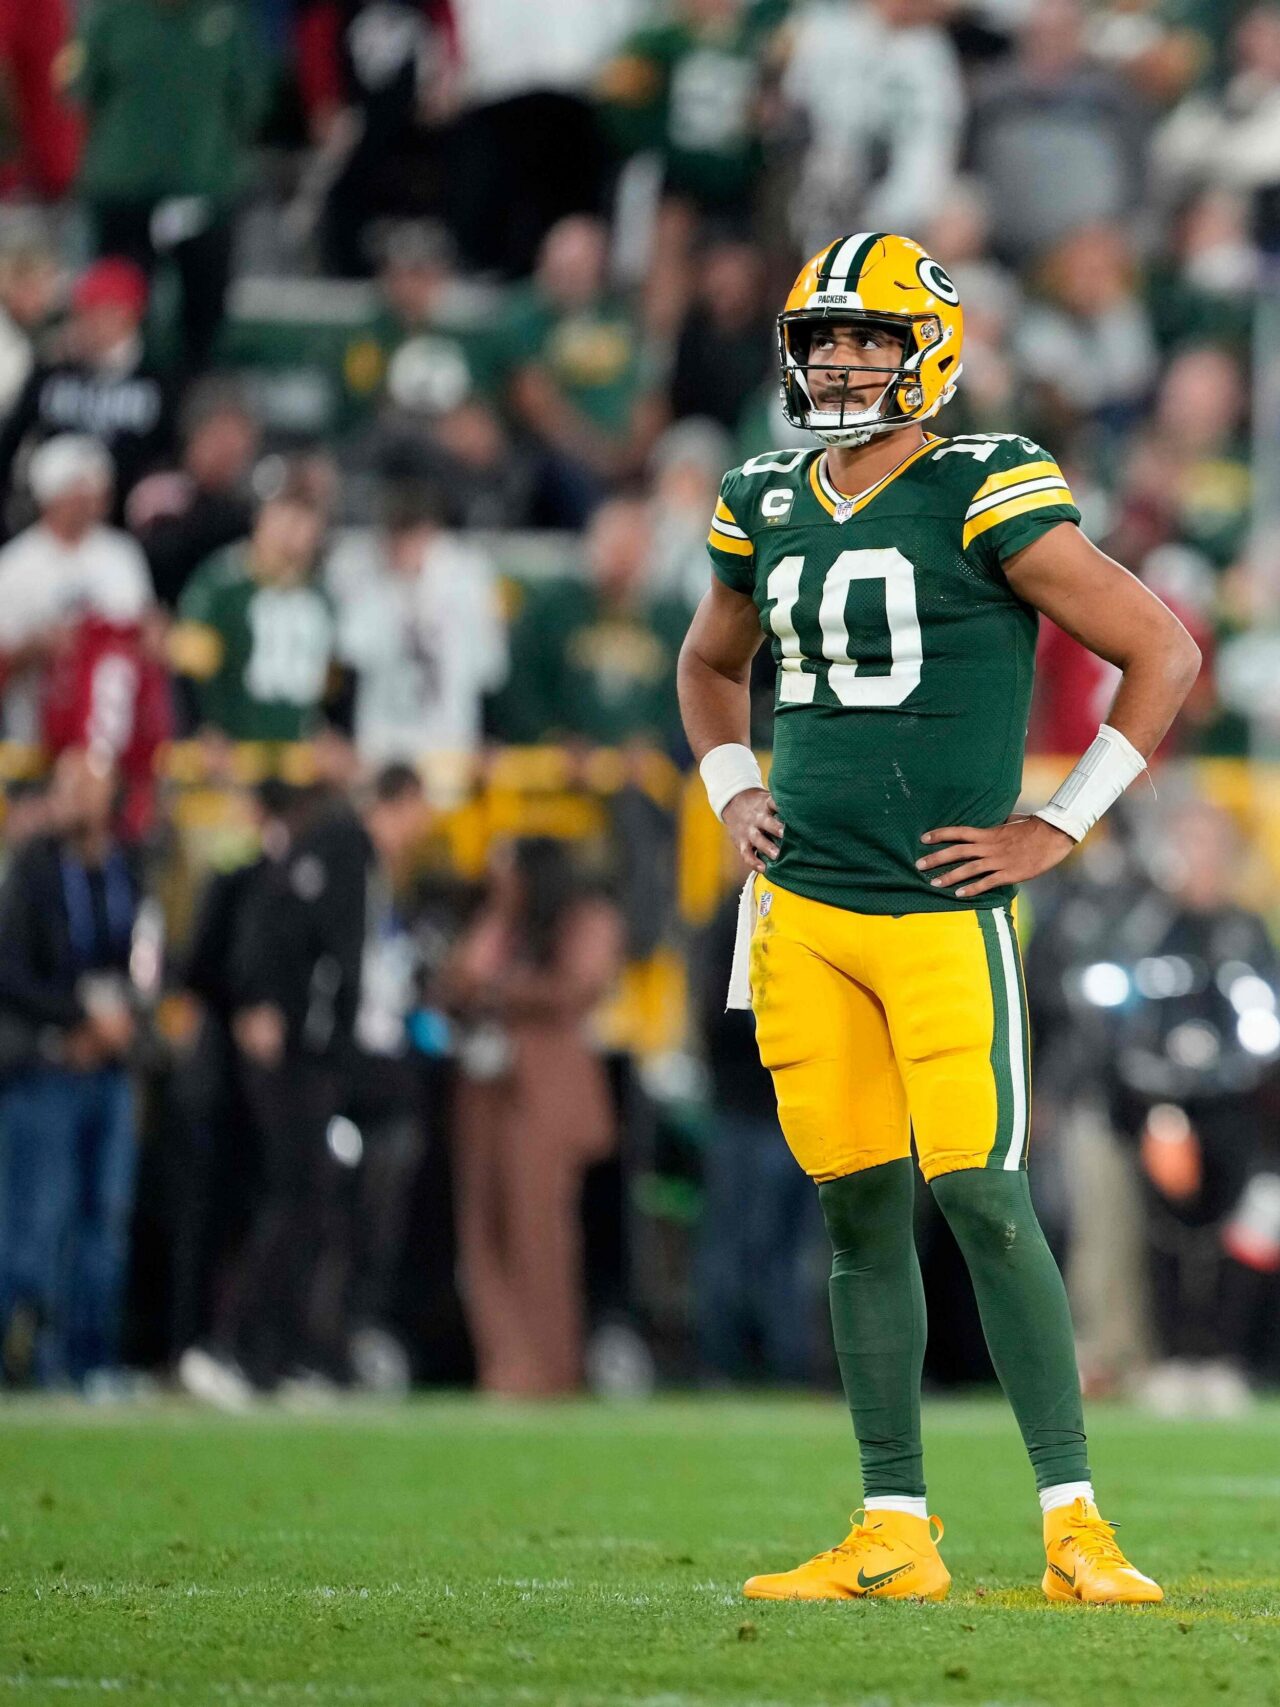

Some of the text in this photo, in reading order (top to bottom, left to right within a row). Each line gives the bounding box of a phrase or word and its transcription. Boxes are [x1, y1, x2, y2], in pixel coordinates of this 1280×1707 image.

[817, 294, 848, 305] PACKERS
[761, 488, 794, 517] C
[766, 546, 924, 707] 10
